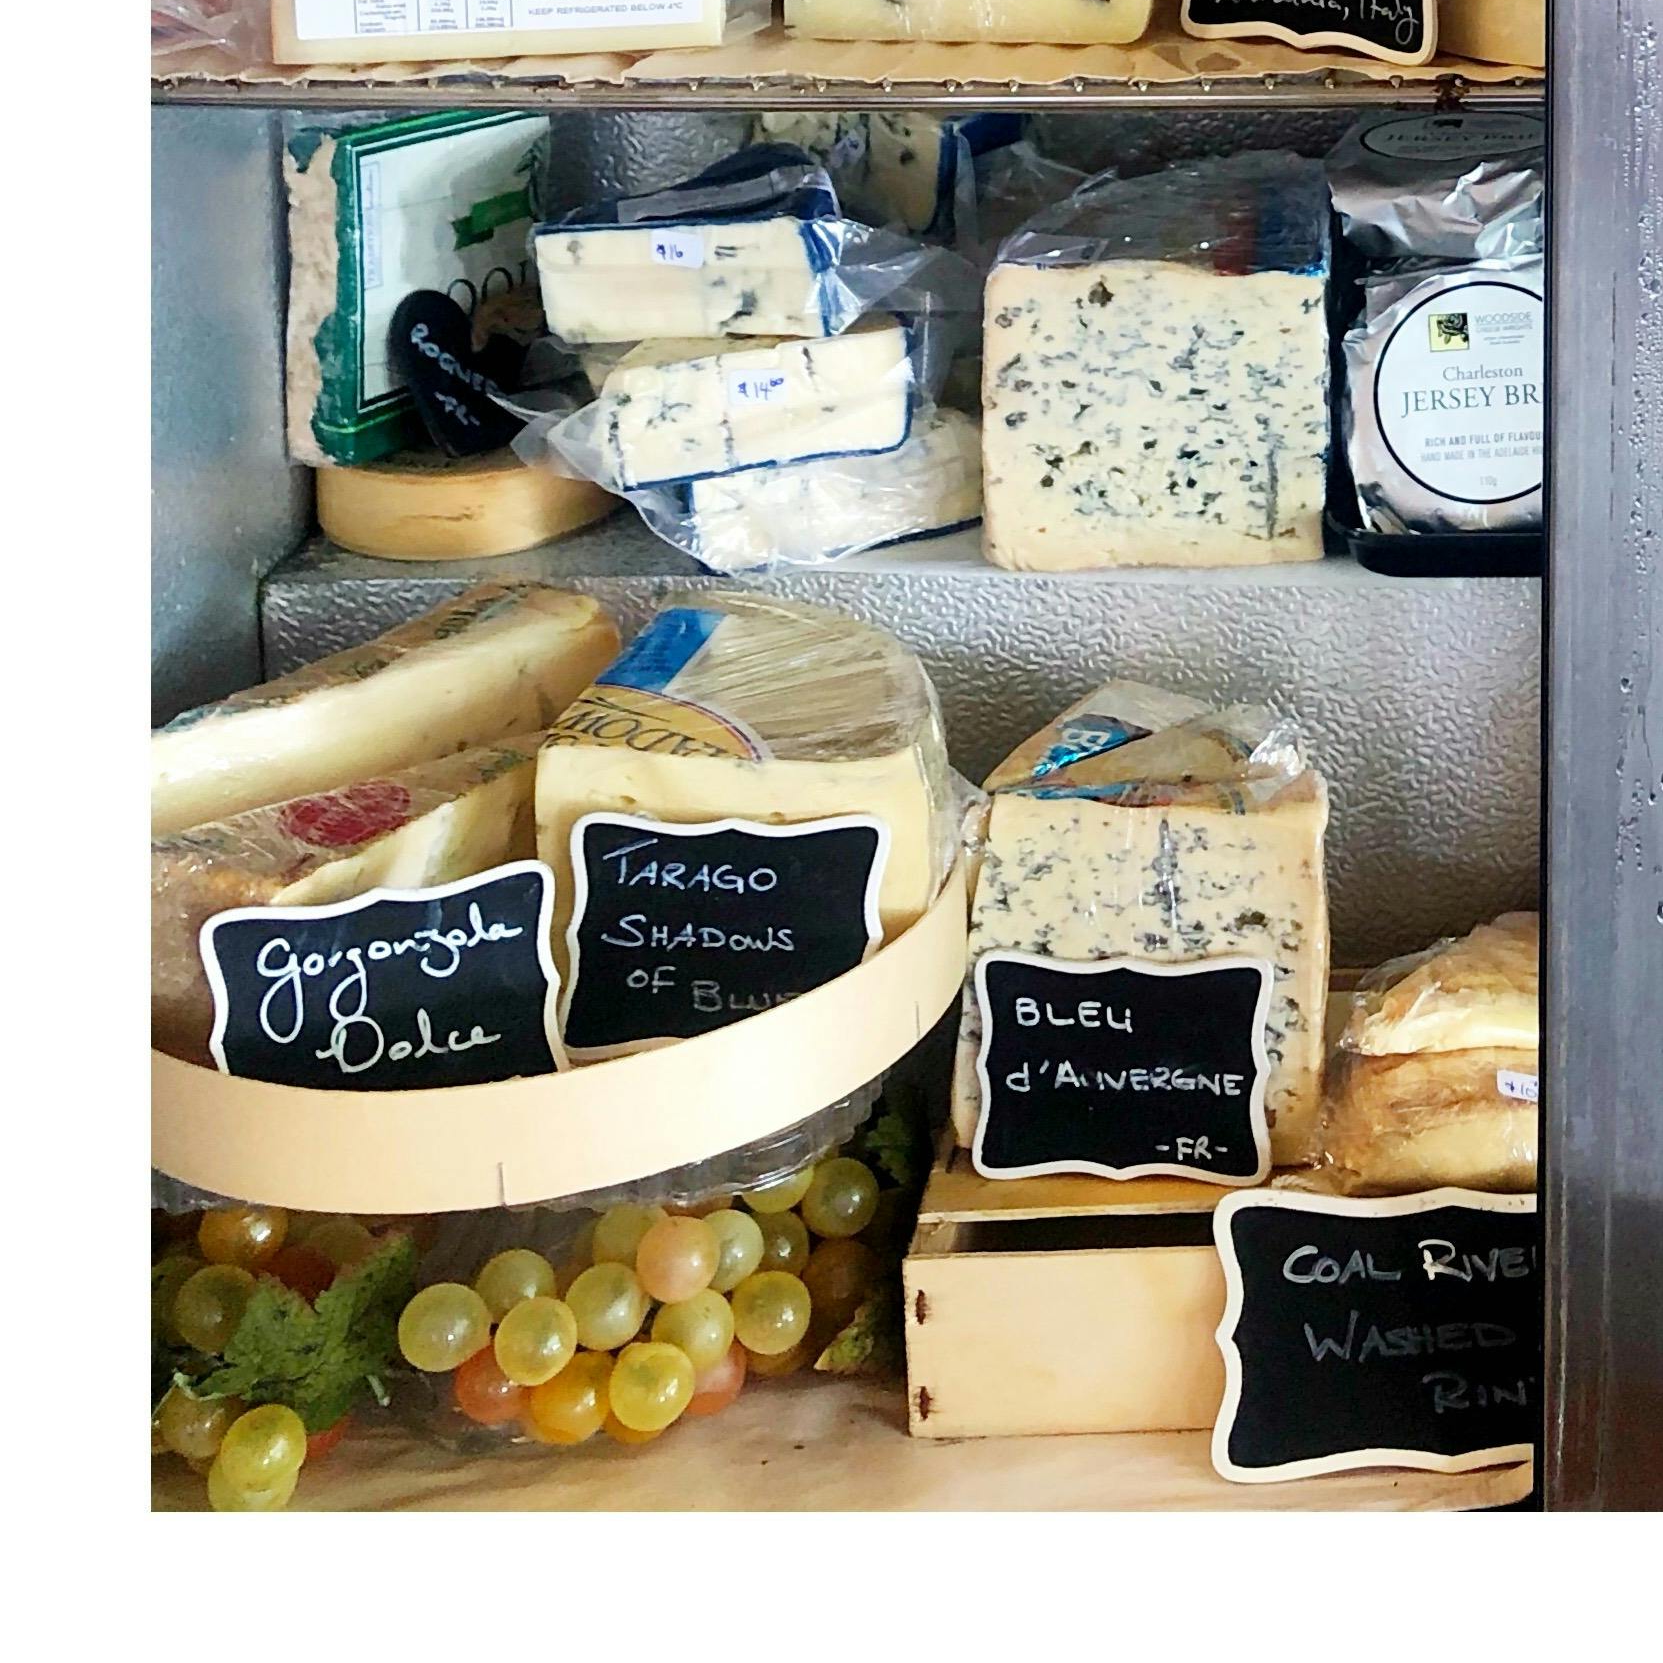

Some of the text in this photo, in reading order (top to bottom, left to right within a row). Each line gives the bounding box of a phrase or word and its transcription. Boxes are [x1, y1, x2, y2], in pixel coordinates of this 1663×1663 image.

[556, 4, 627, 14] REFRIGERATED
[1474, 311, 1533, 325] WOODSIDE
[1442, 364, 1524, 381] Charleston
[1400, 386, 1497, 419] JERSEY
[1424, 433, 1505, 447] RICH AND FULL OF
[602, 838, 778, 894] TARAGO
[600, 914, 795, 952] SHADOWS
[626, 965, 677, 995] OF
[1015, 997, 1133, 1033] BLEU
[315, 1007, 501, 1073] Dolce
[1282, 1237, 1537, 1284] COAL RIVE
[1303, 1309, 1517, 1363] WASHED
[1422, 1368, 1536, 1414] RIN
